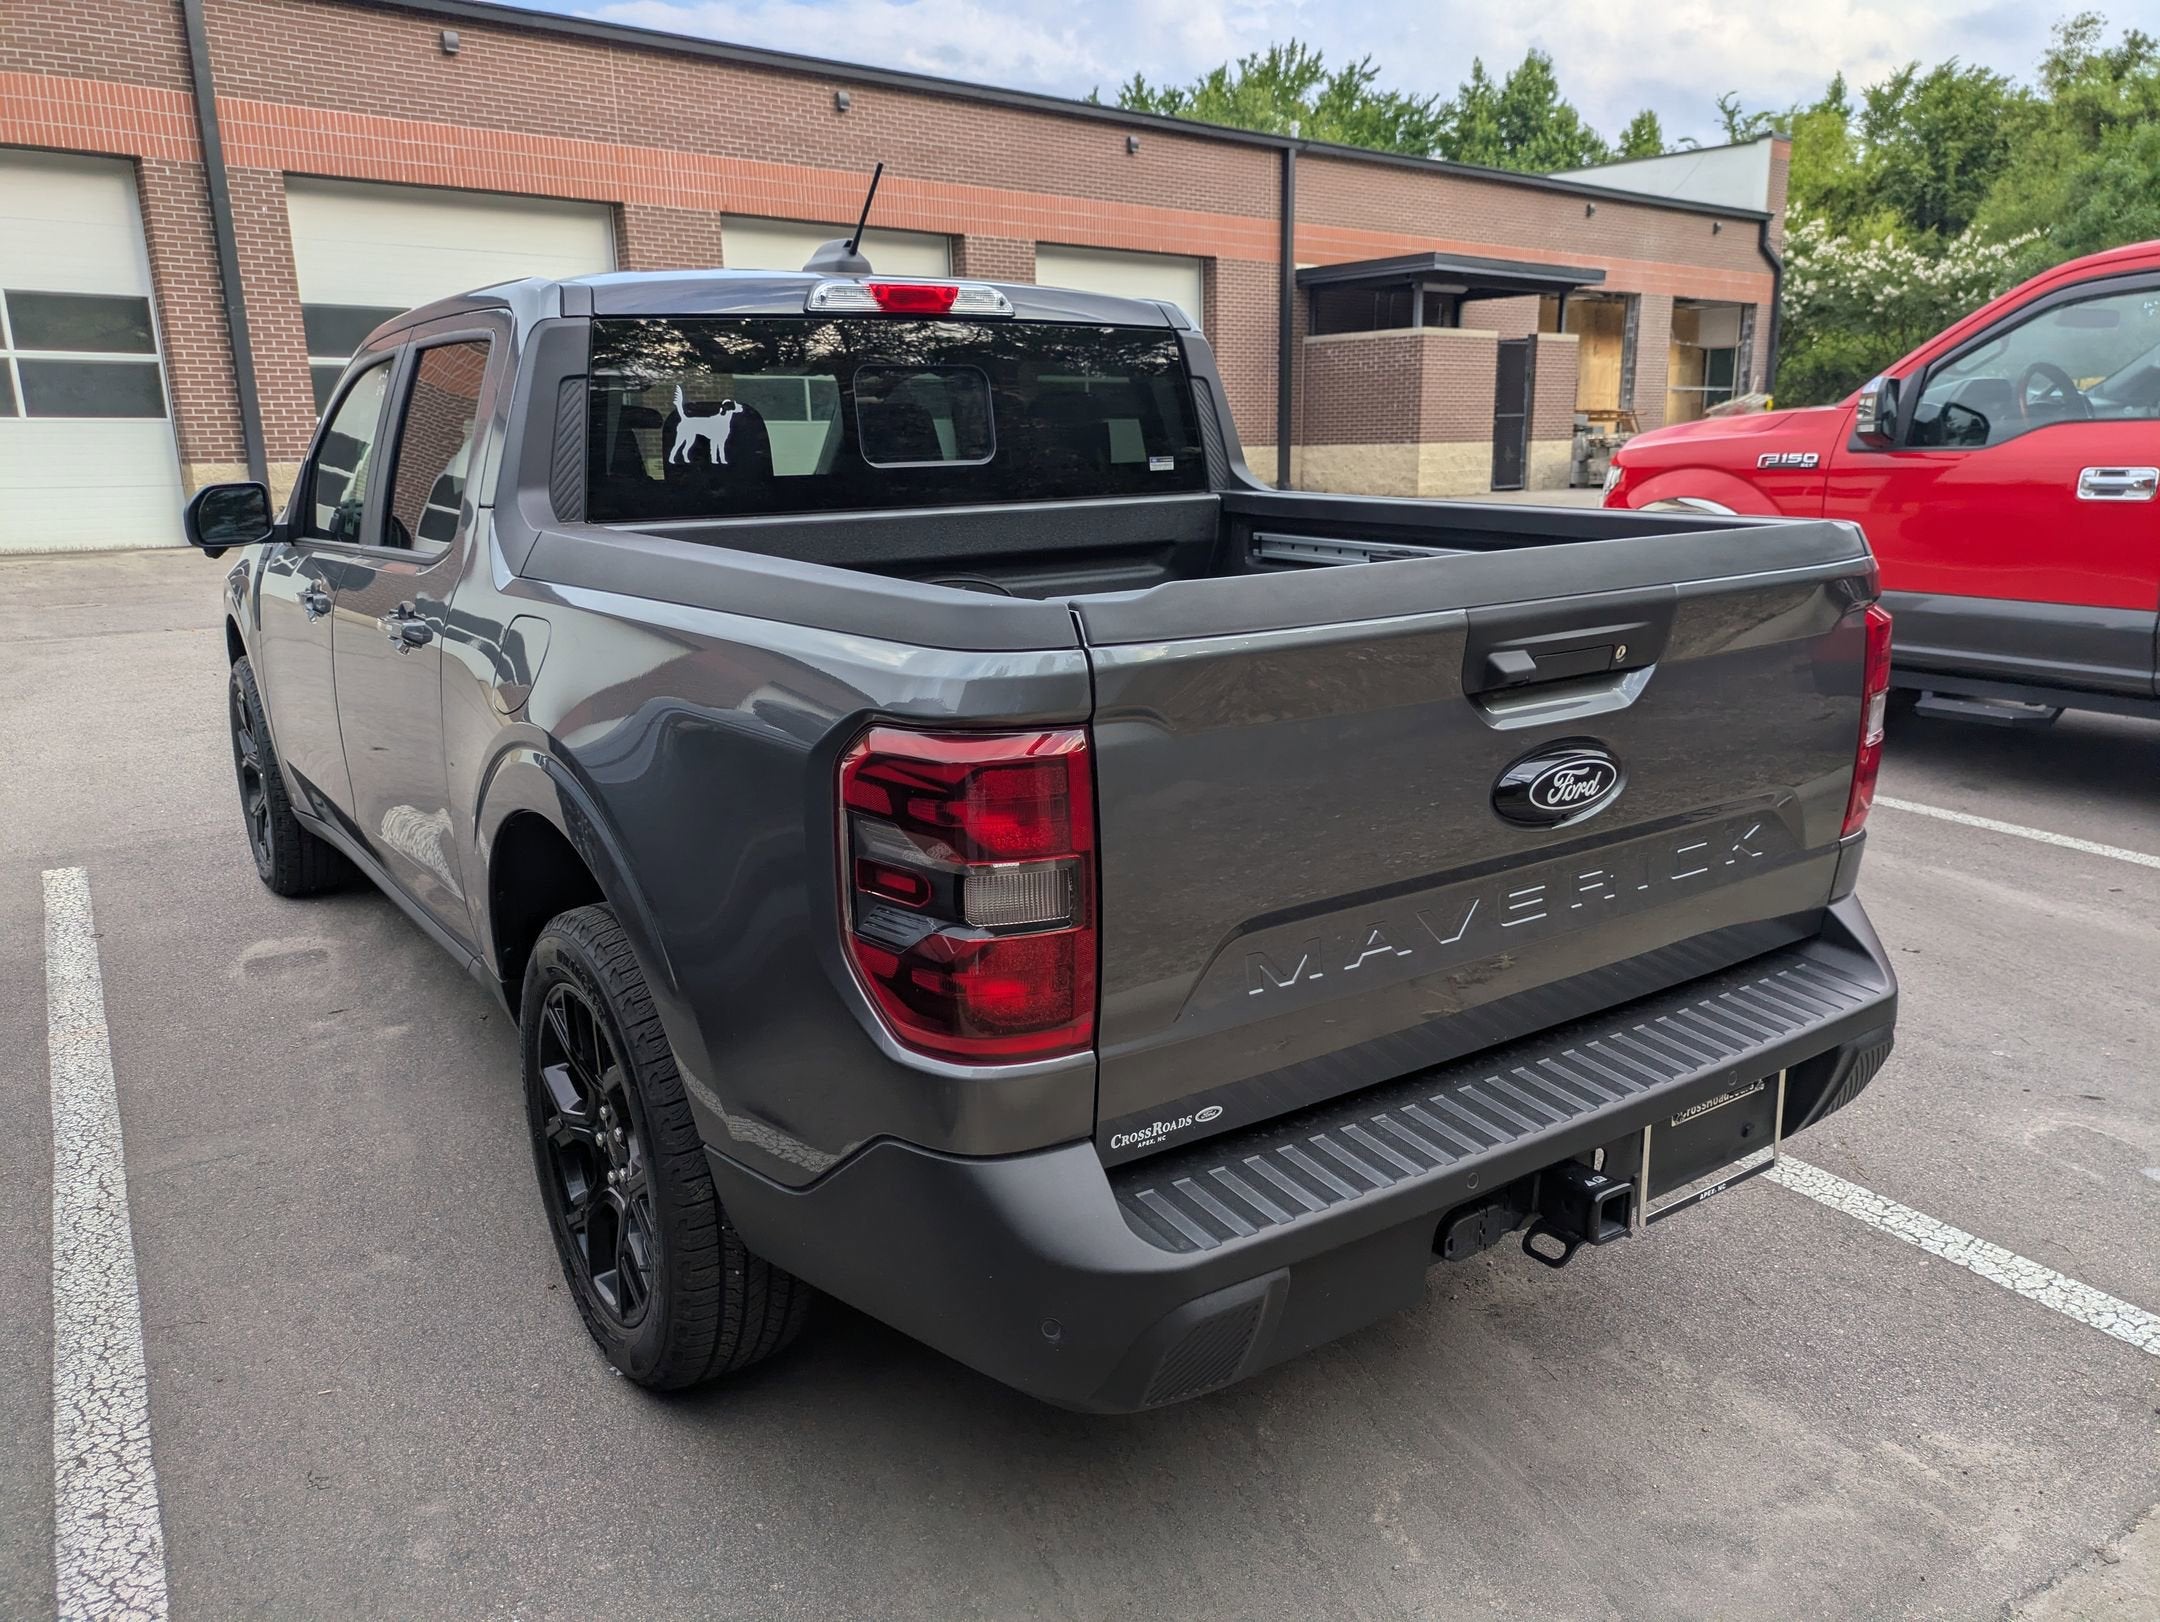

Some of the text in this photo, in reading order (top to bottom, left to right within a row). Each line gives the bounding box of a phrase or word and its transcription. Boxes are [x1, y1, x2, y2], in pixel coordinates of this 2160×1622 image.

[1547, 767, 1602, 804] Ford
[1246, 823, 1764, 995] MAVERICK
[1157, 1134, 1166, 1142] NC
